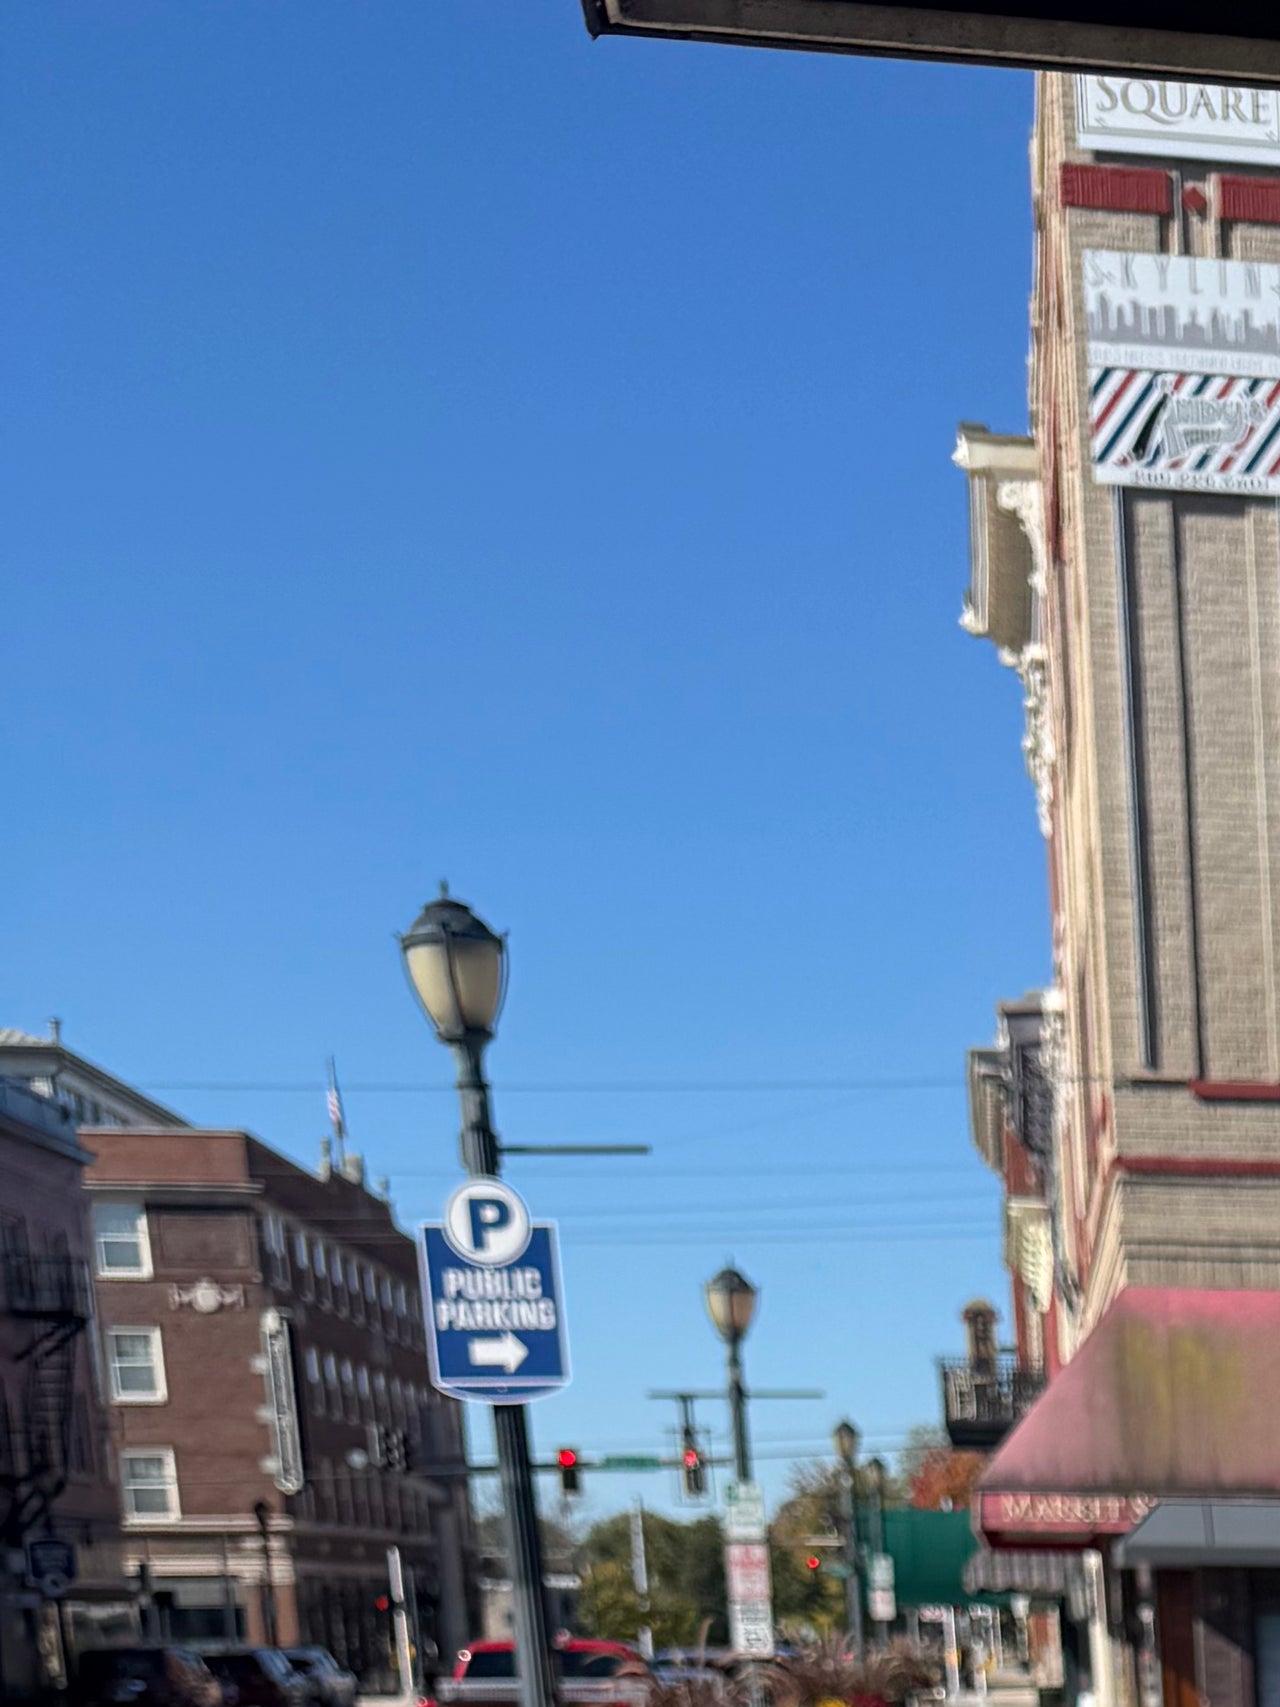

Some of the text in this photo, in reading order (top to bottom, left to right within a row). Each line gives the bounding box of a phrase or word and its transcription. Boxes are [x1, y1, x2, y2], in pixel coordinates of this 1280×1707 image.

[1096, 76, 1272, 125] SQUARE
[467, 1197, 510, 1252] P
[444, 1267, 542, 1298] PUBLIC
[437, 1299, 556, 1331] PARKING
